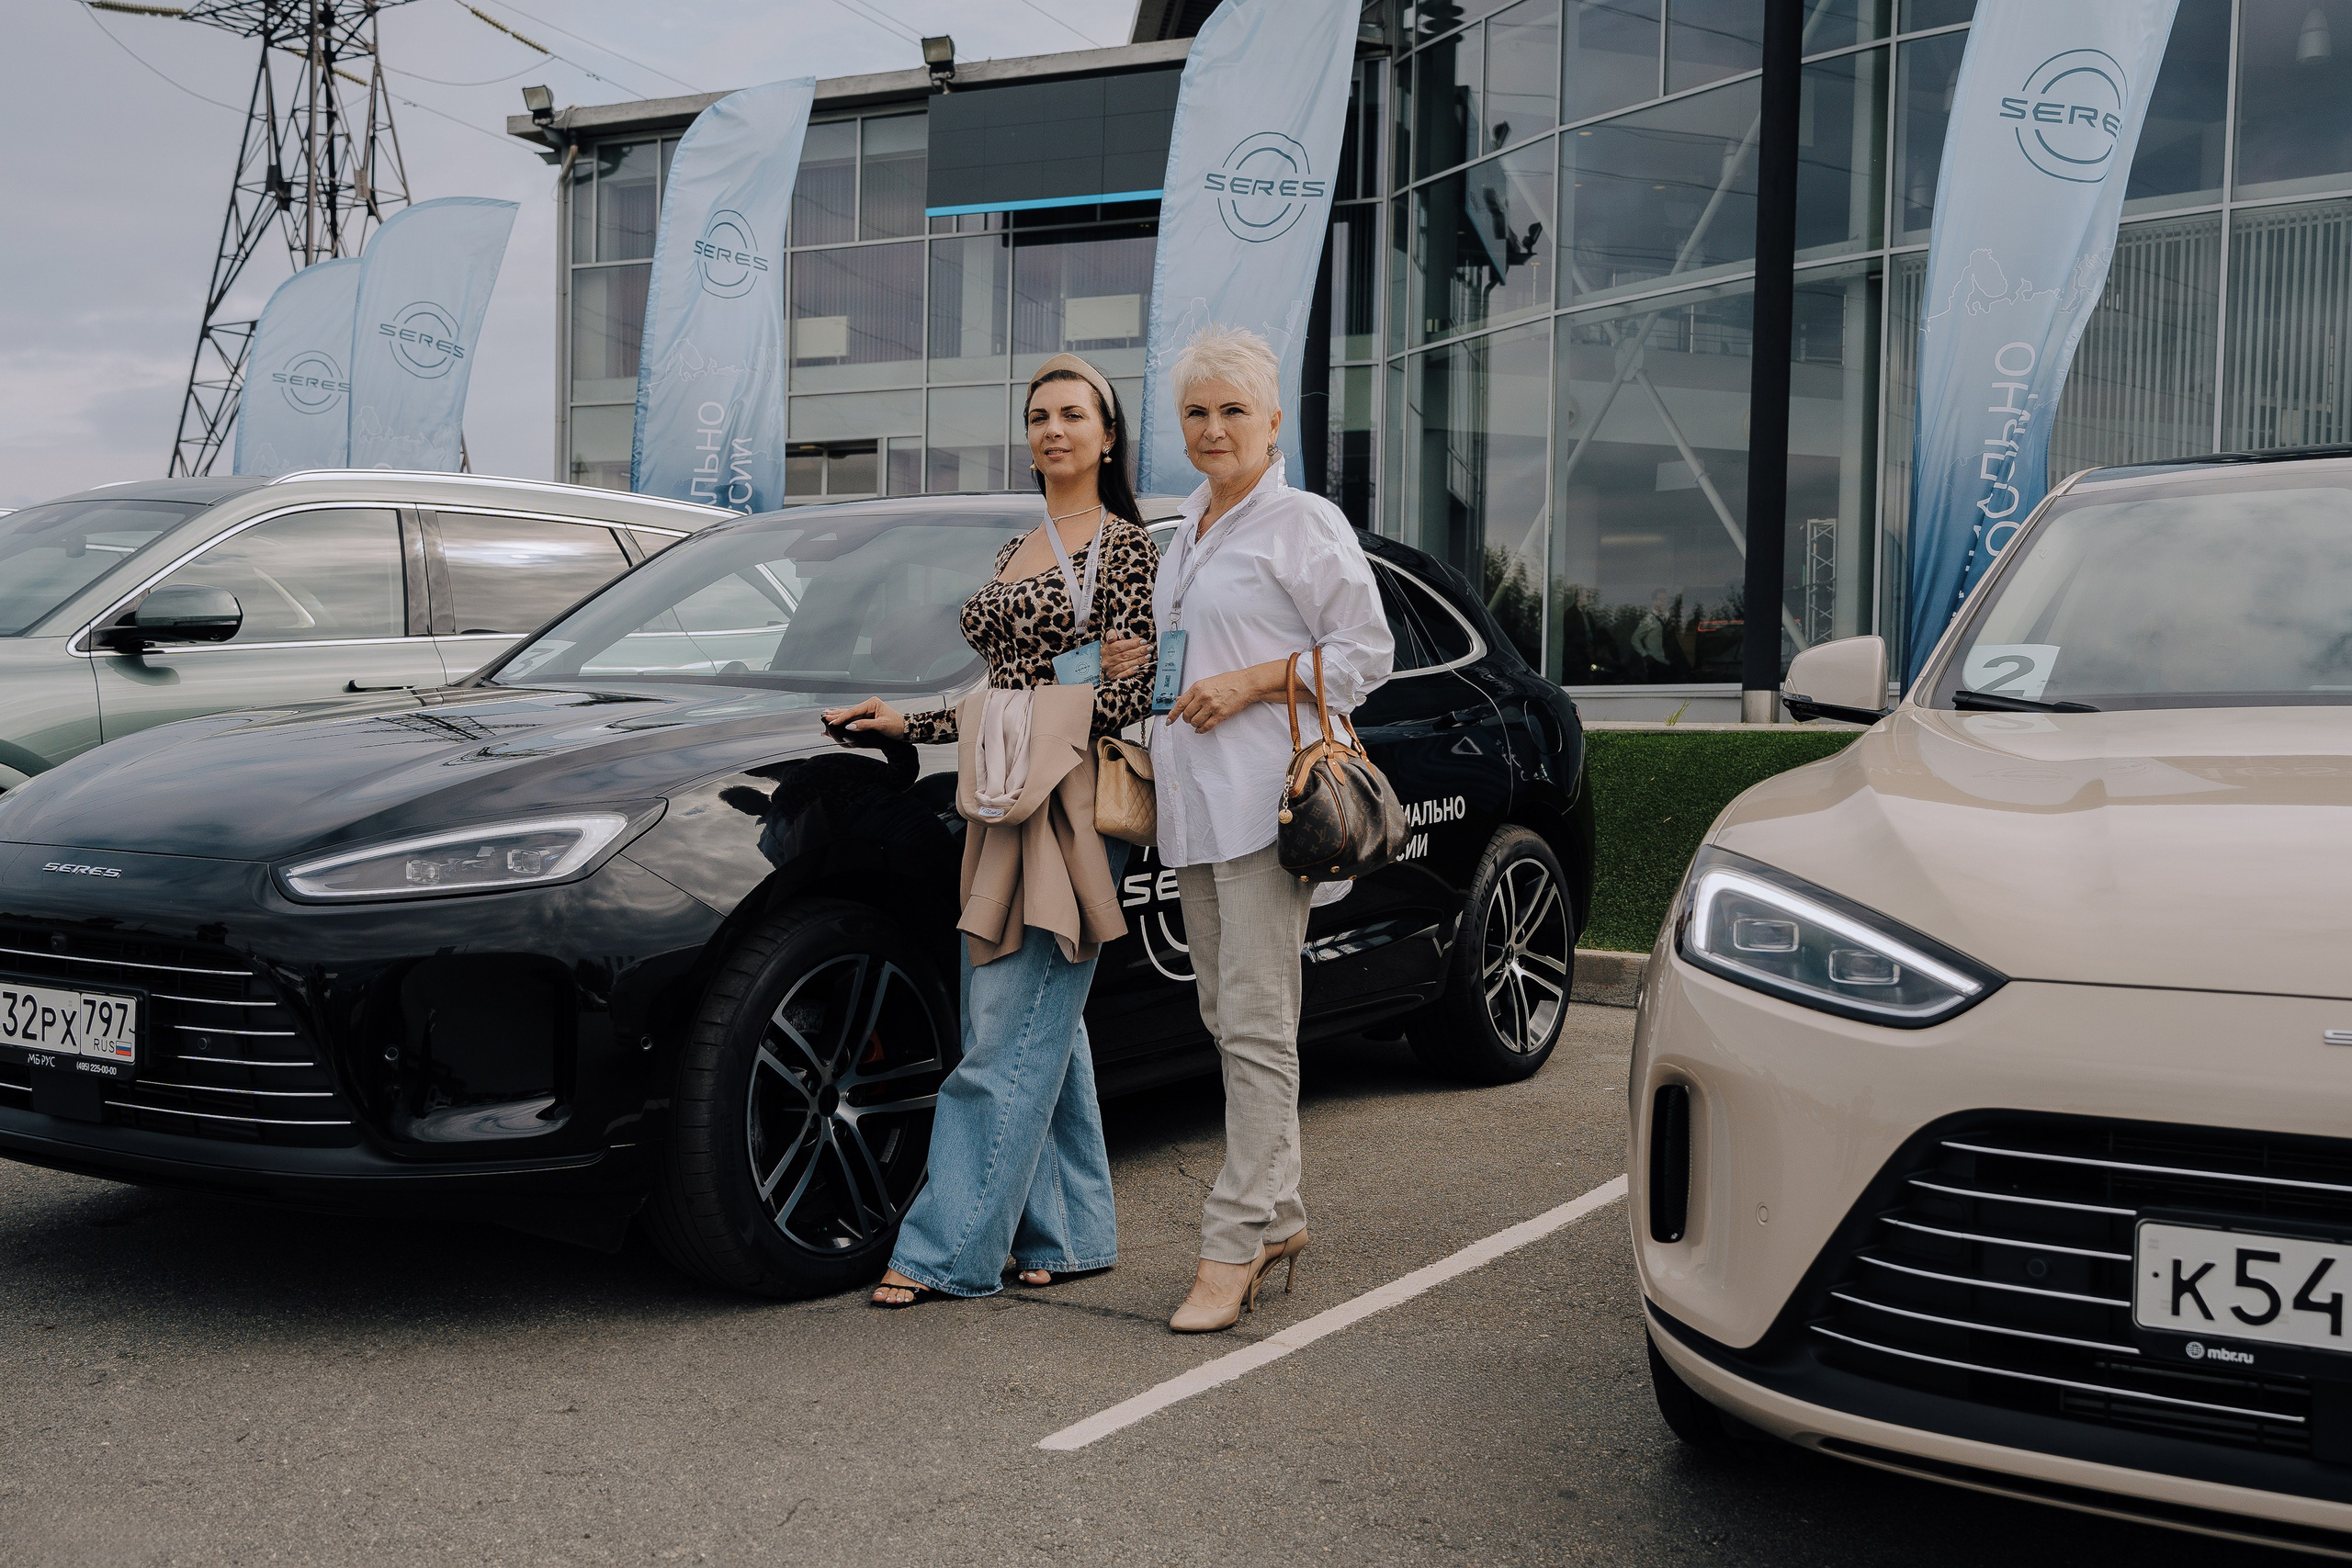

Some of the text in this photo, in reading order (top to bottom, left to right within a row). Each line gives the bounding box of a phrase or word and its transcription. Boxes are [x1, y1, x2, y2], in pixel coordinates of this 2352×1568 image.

[1999, 96, 2122, 139] SERE
[1204, 172, 1326, 197] SERES
[693, 240, 768, 272] SERES
[379, 323, 466, 359] SERES
[272, 372, 351, 393] SERES
[690, 400, 725, 506] ЛЬНО
[1973, 654, 2036, 697] 2
[42, 862, 122, 878] SERES
[83, 998, 129, 1040] 797
[93, 1038, 116, 1054] RUS
[76, 1062, 118, 1076] (495) 225-00-00
[2207, 1348, 2255, 1365] mbr.ru
